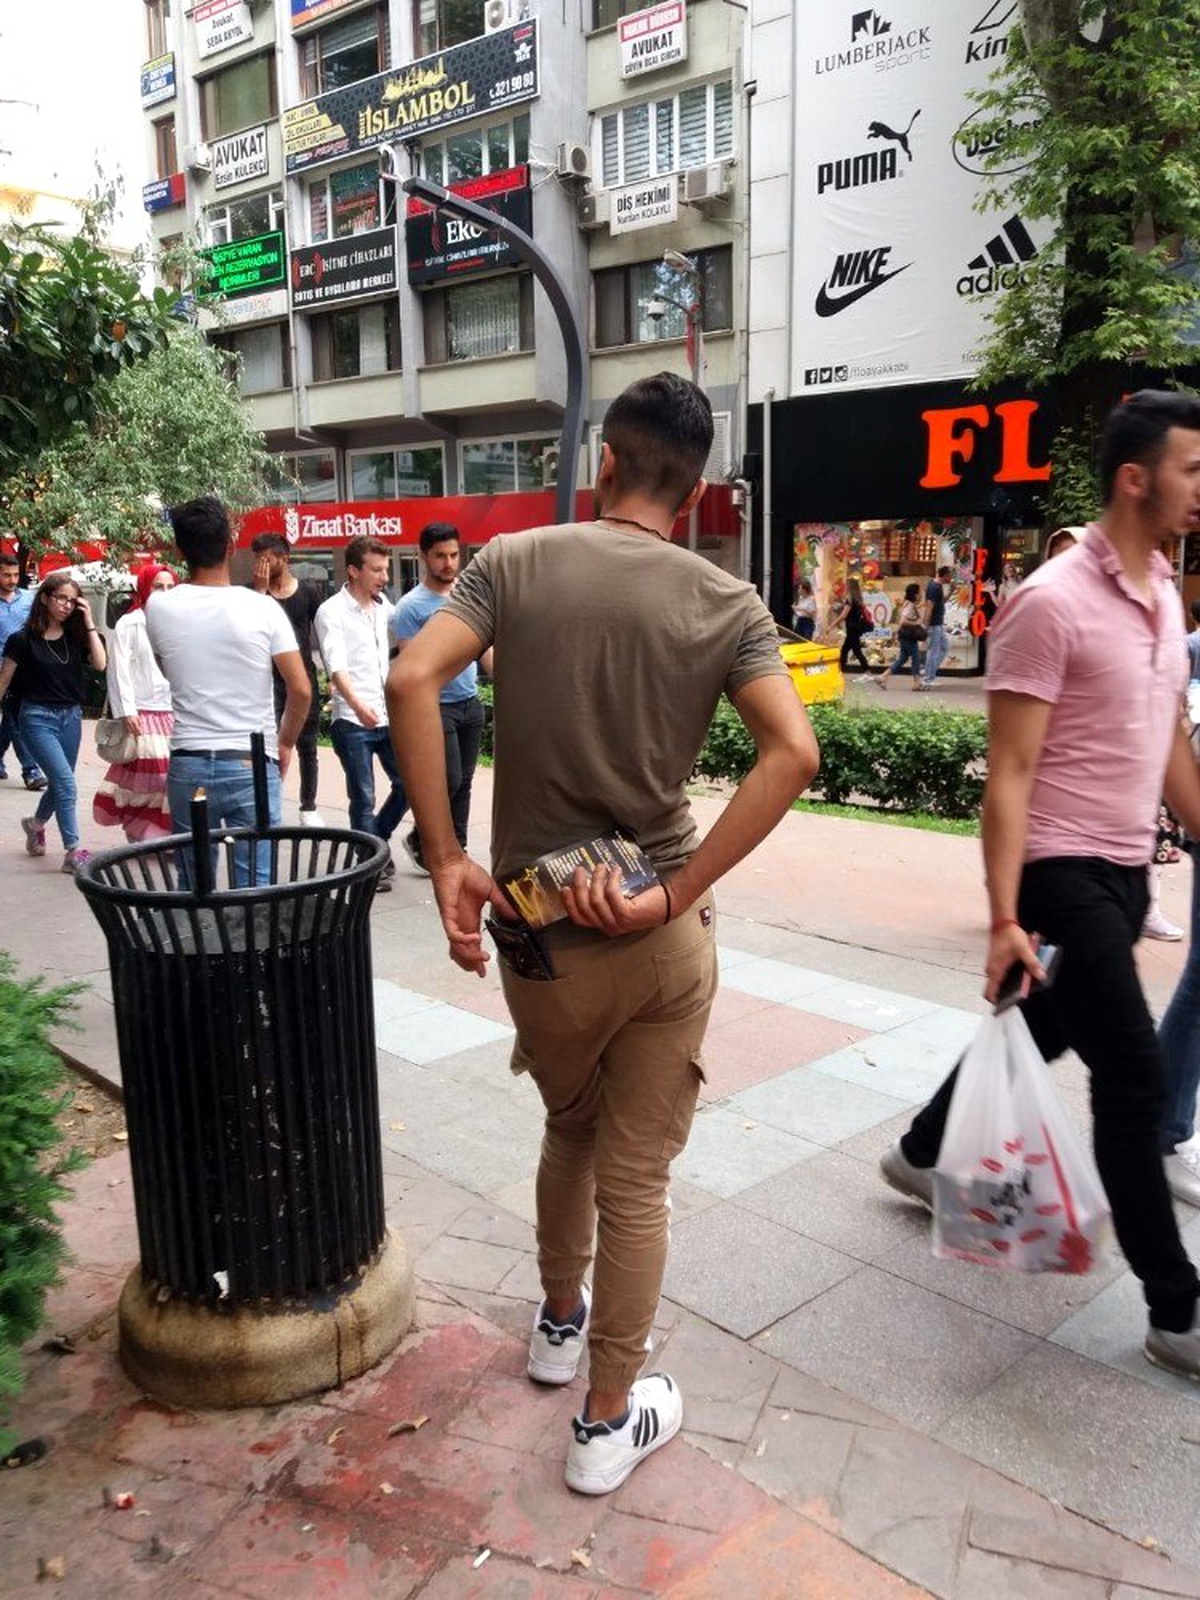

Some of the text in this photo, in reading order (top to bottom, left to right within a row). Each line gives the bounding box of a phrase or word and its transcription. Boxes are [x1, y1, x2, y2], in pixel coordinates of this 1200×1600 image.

[631, 30, 673, 59] AVUKAT
[815, 26, 931, 75] LUMBERJACK
[964, 36, 1009, 65] kin
[215, 131, 265, 168] AVUKAT
[817, 147, 897, 195] PUMA
[828, 246, 892, 289] NIKE
[919, 398, 1053, 490] FL
[301, 512, 402, 538] Ziraat Bankası
